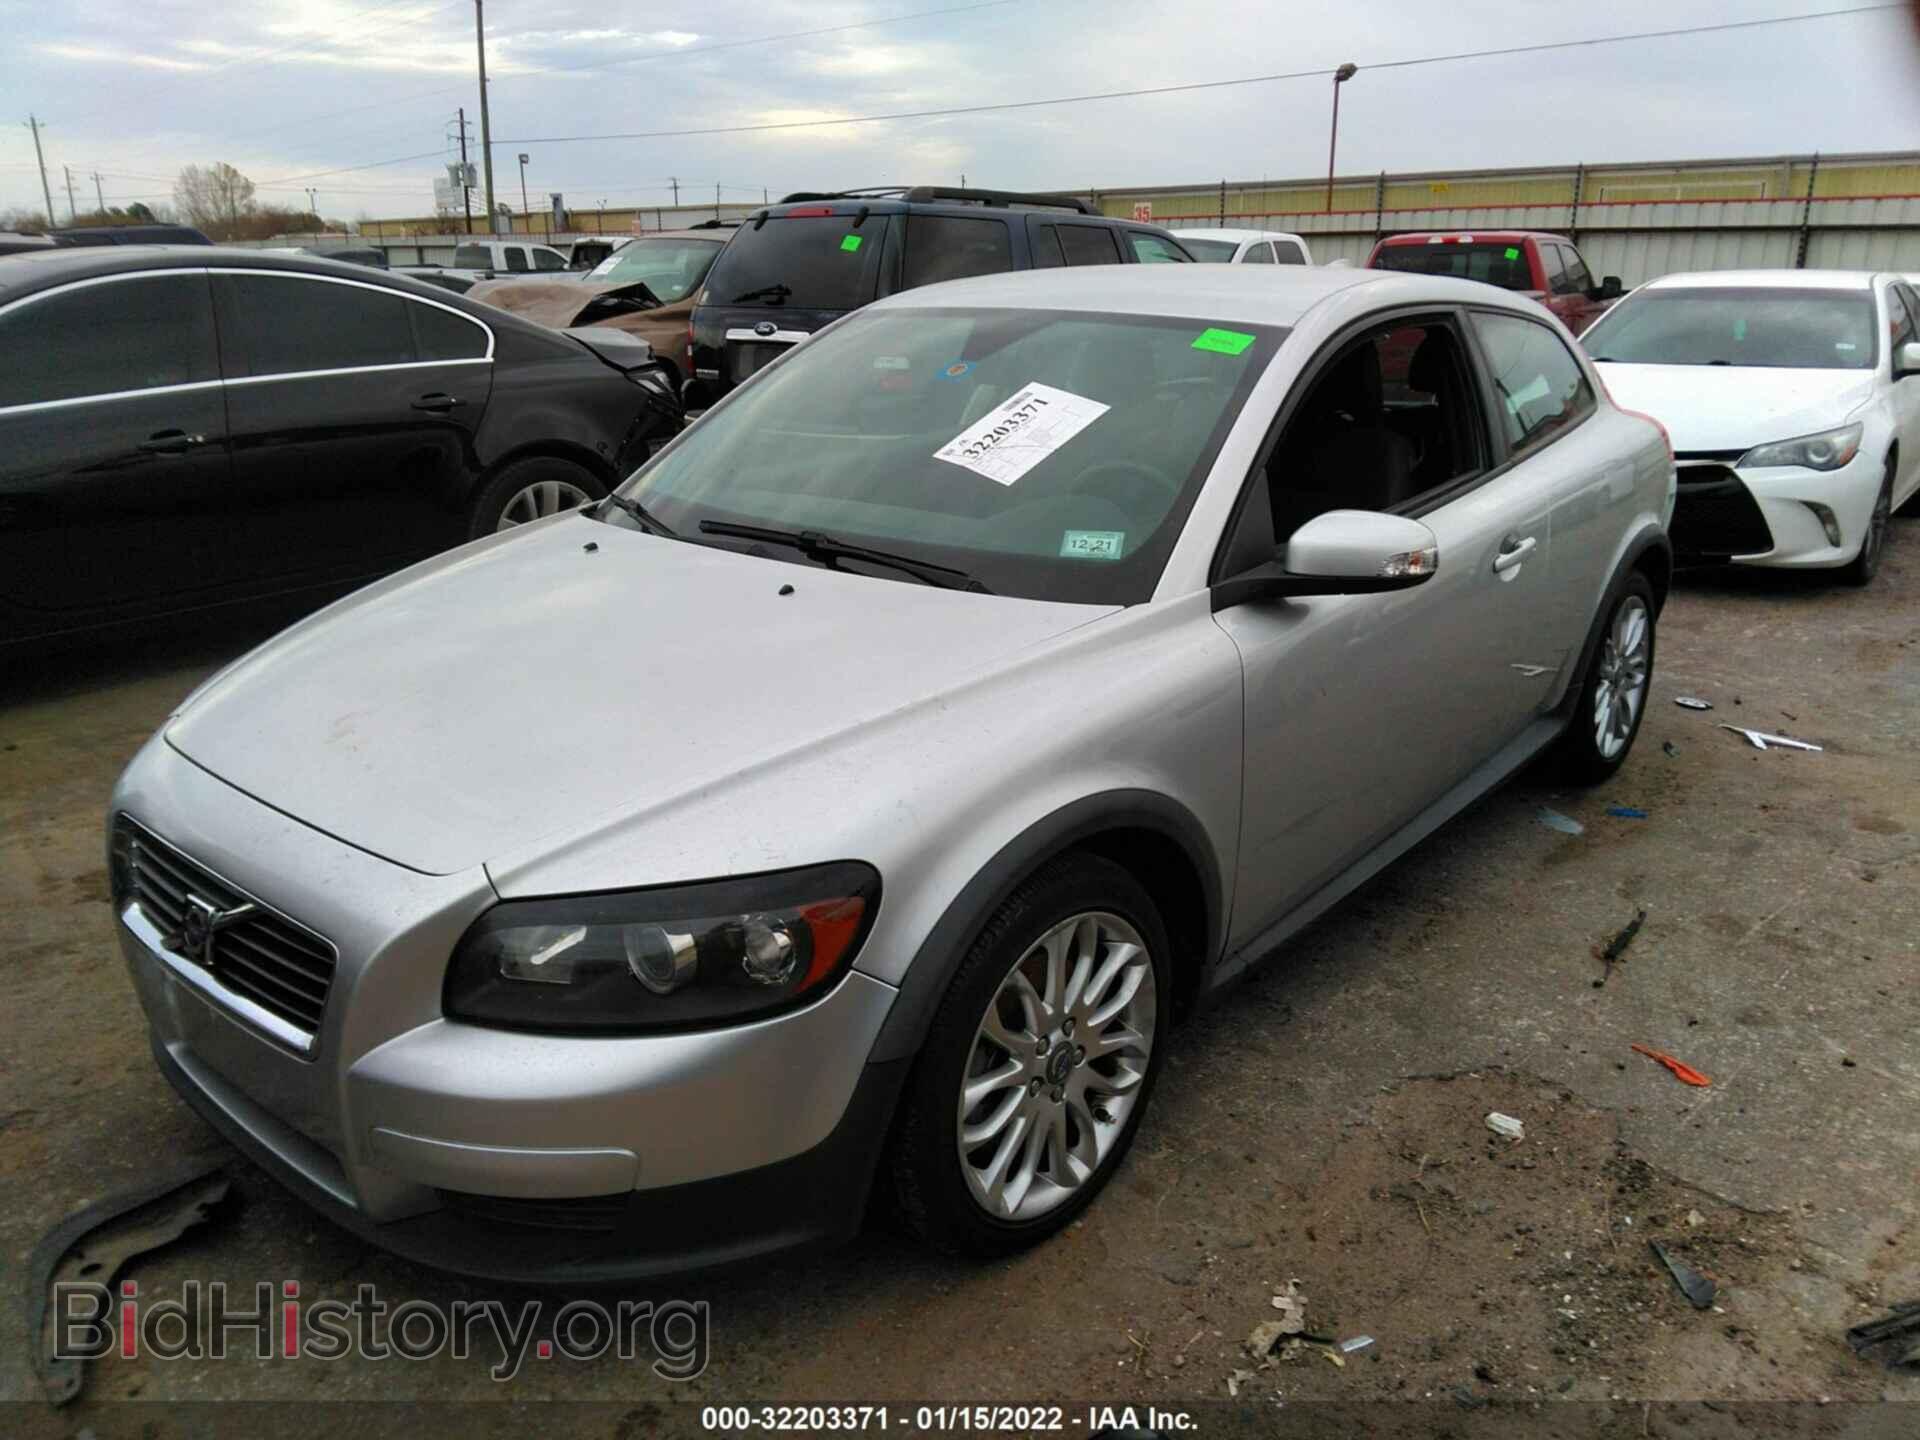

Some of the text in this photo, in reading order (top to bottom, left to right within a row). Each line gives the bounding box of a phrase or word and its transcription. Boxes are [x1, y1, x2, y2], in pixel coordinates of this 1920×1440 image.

[962, 398, 1049, 460] 32203371
[1071, 539, 1112, 550] 12 21
